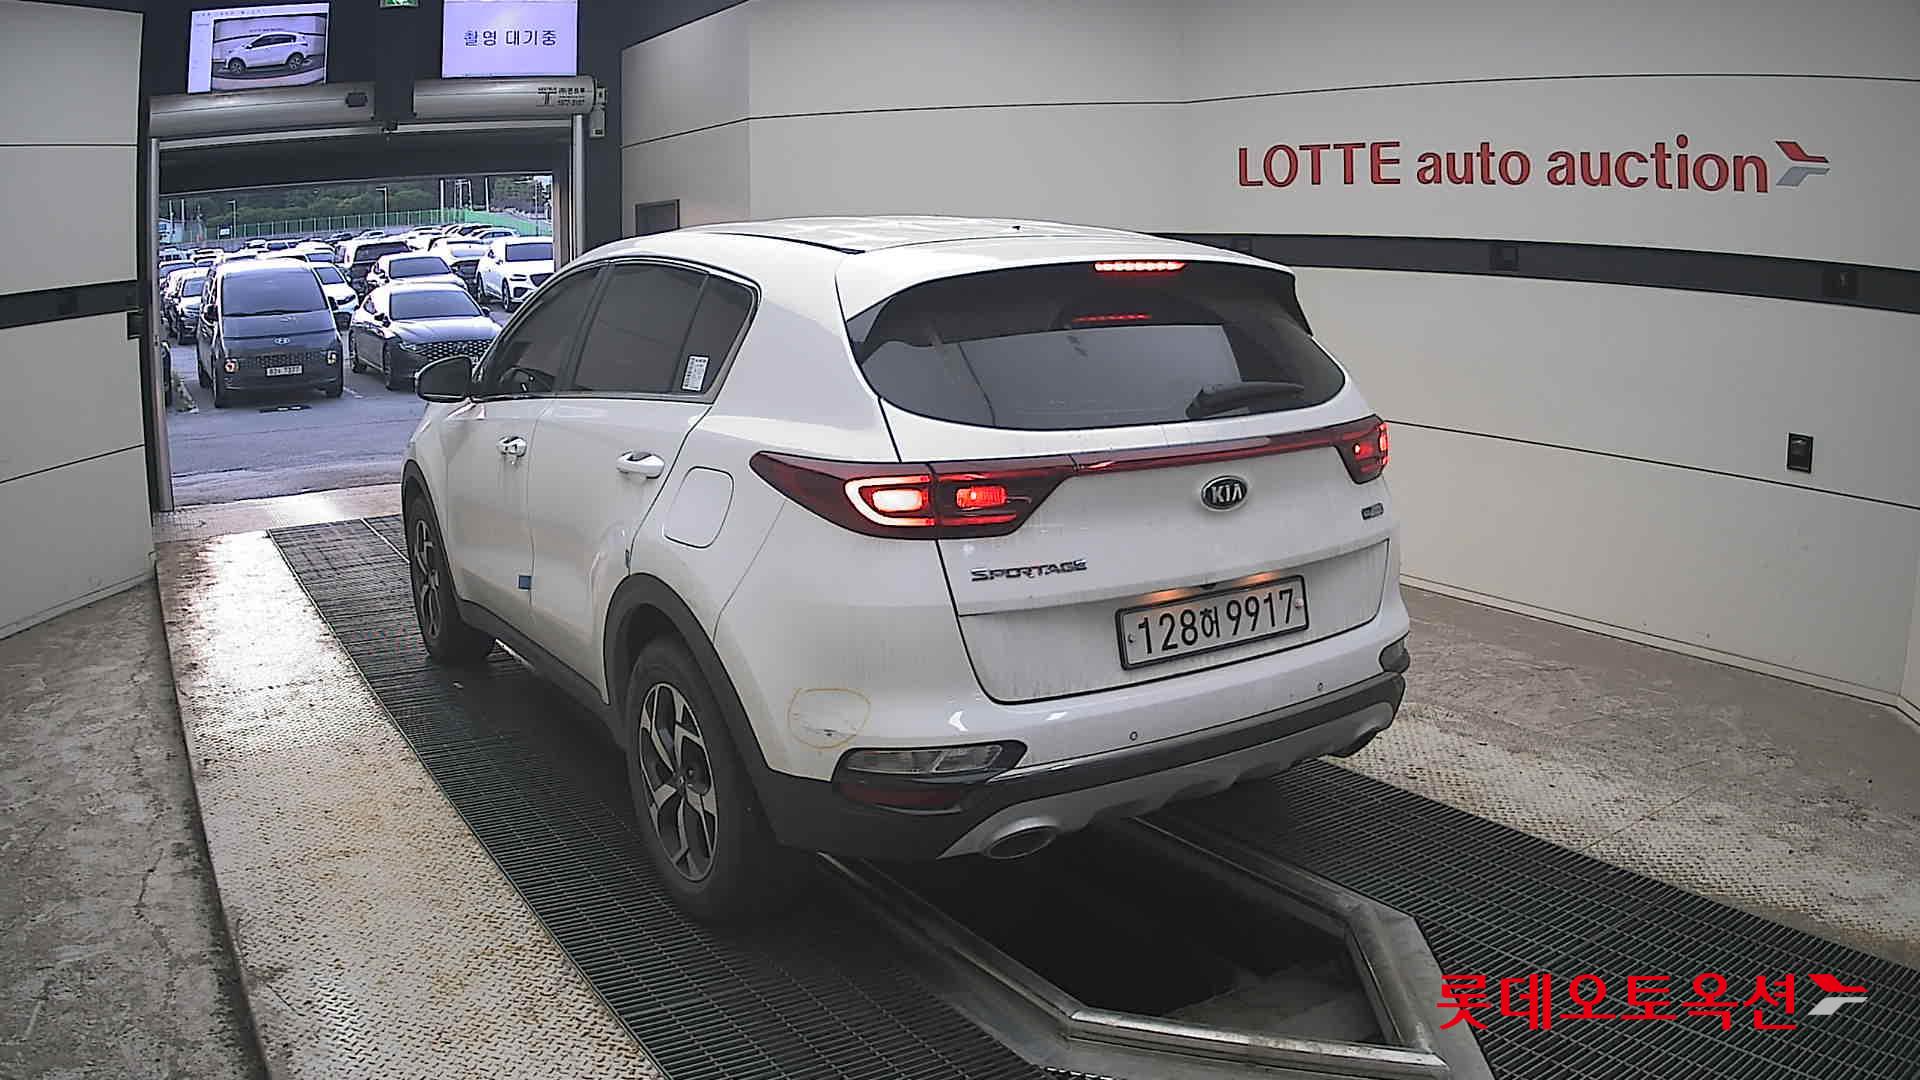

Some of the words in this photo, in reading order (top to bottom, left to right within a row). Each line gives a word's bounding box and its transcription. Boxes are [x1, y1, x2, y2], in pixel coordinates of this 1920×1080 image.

[506, 30, 556, 46] 대기중
[1238, 141, 1401, 187] LOTTE
[1416, 142, 1530, 186] auto
[1546, 134, 1769, 193] auction
[1211, 483, 1242, 503] KIA
[971, 560, 1087, 581] SPORTAGE
